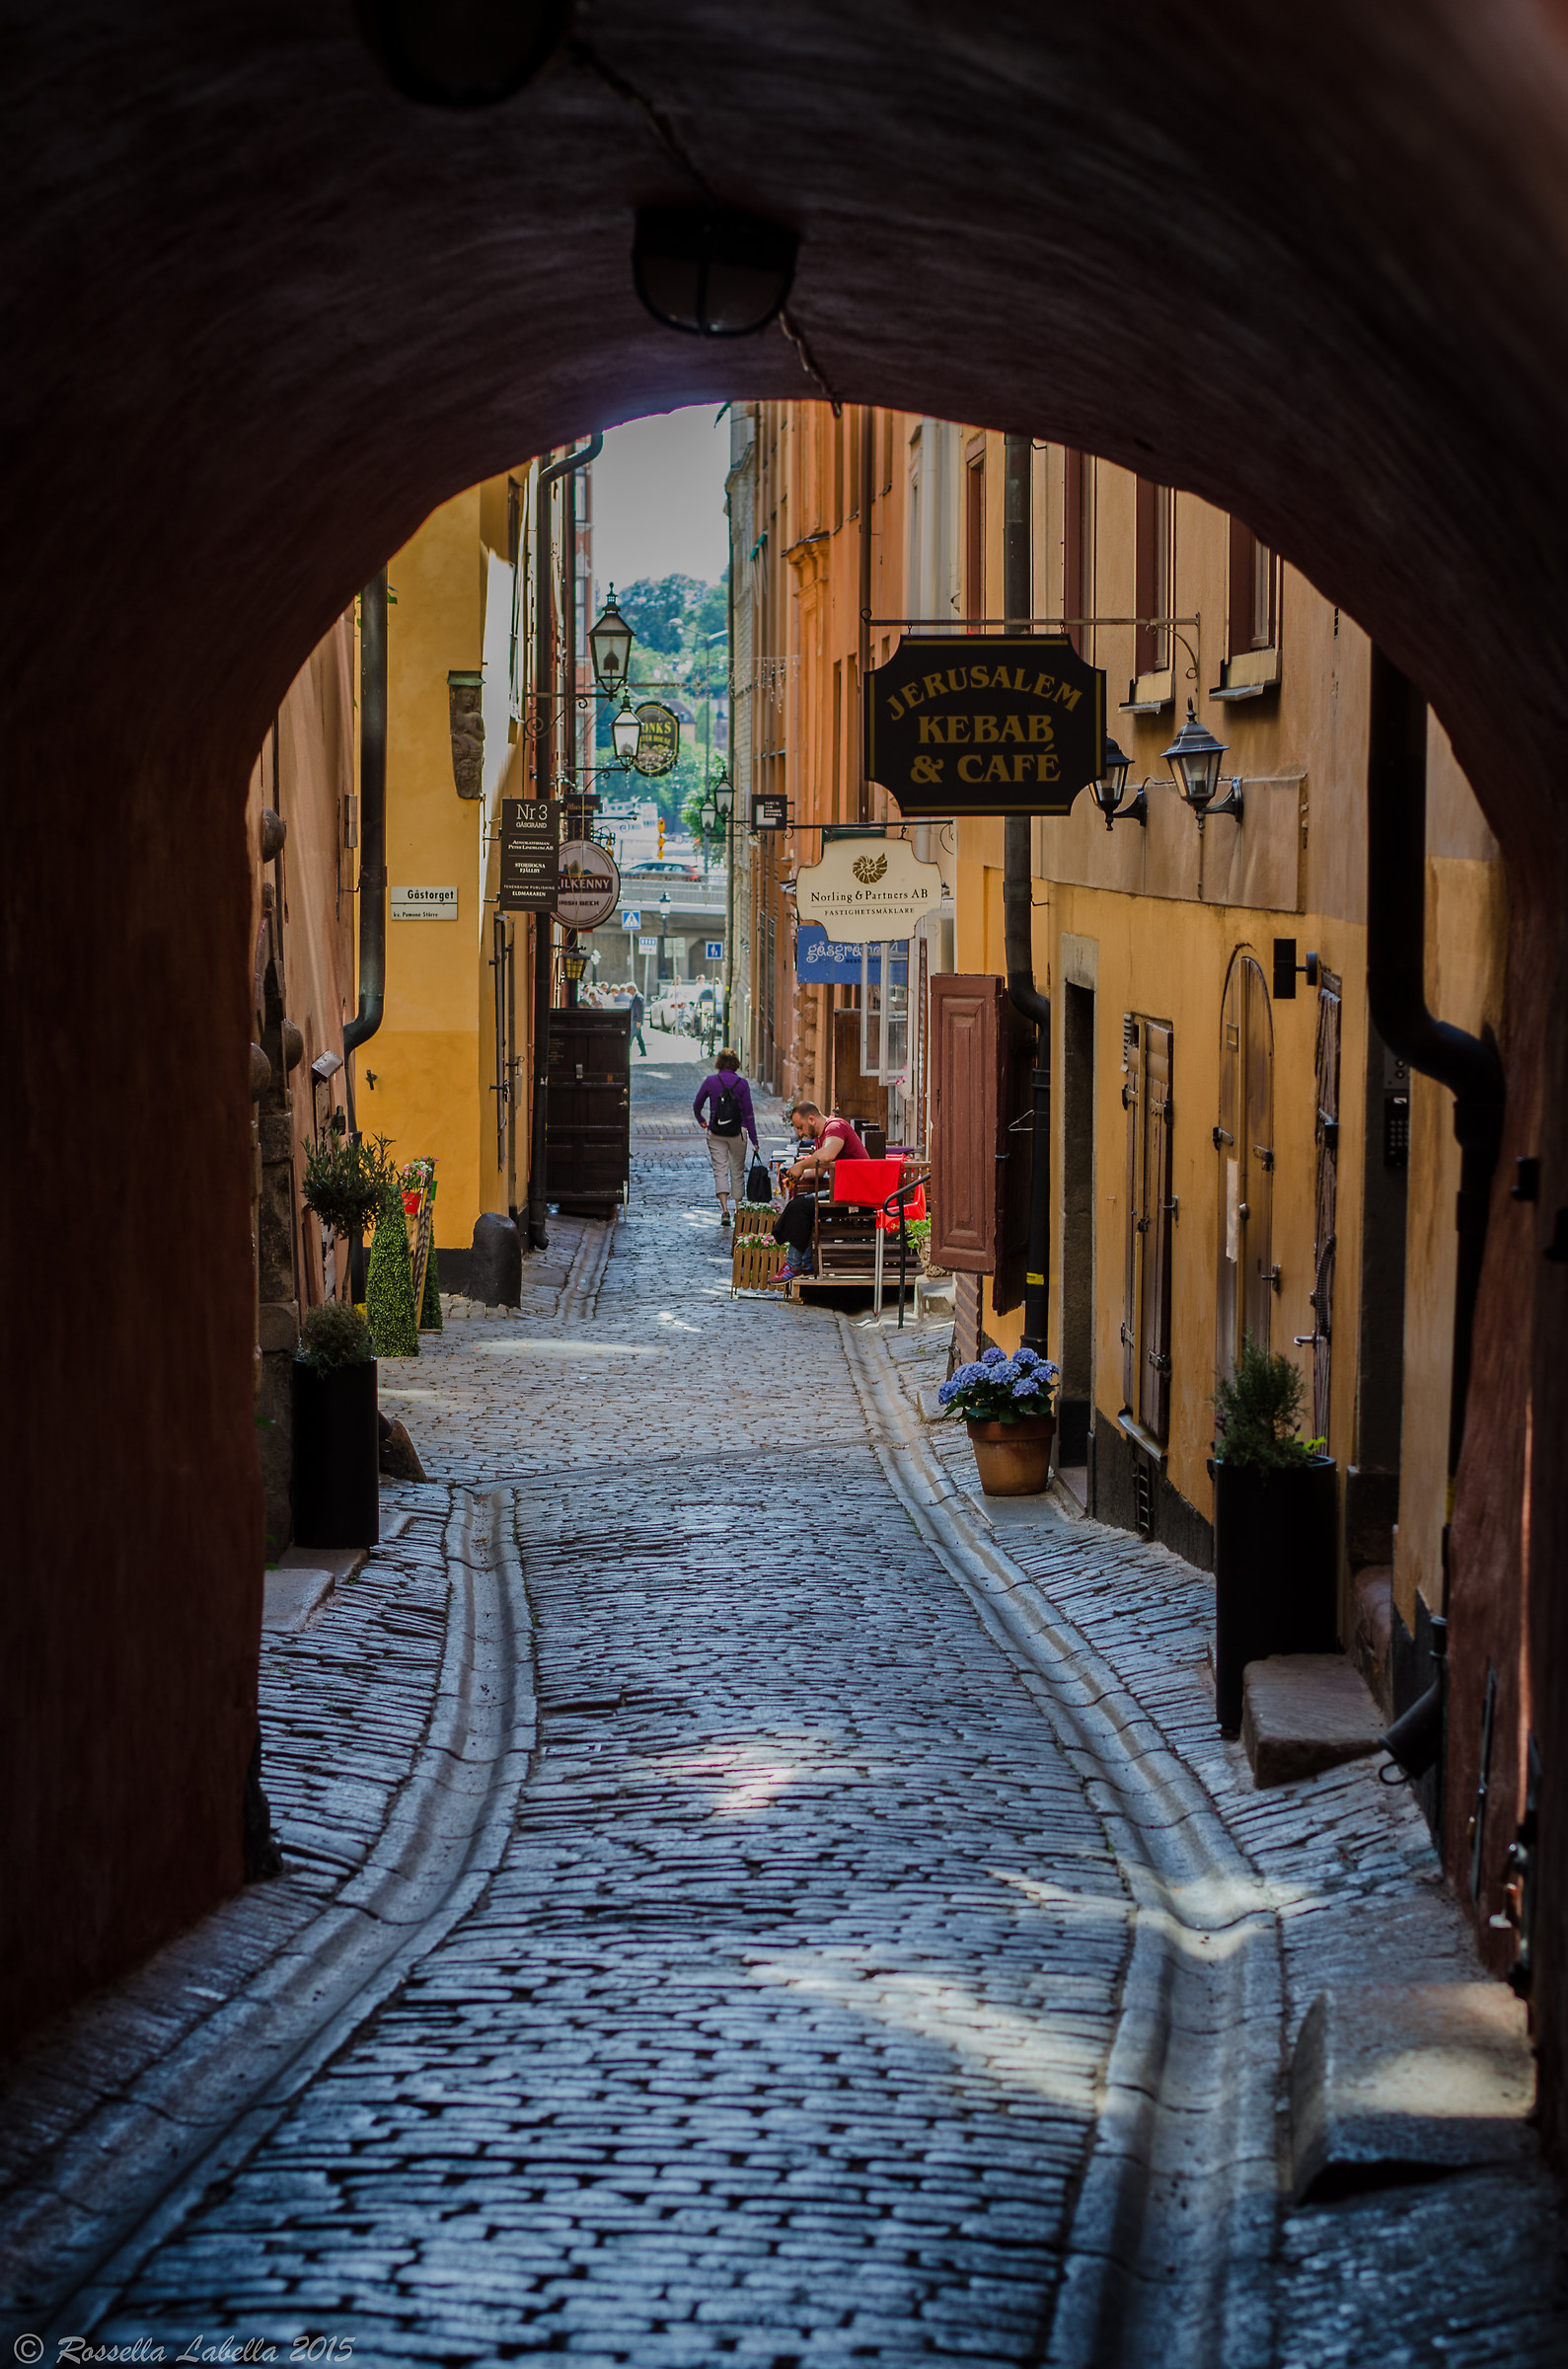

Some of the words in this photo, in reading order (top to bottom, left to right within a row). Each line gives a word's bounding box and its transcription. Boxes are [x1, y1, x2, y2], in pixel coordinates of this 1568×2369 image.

[886, 665, 1083, 721] JERUSALEM
[918, 715, 1055, 743] KEBAB
[910, 754, 944, 784] &
[956, 743, 1062, 783] CAFÉ
[516, 803, 536, 820] Nr
[538, 804, 548, 820] 3
[558, 878, 610, 889] ILKENNY
[407, 889, 454, 902] Gåstorget
[810, 891, 853, 904] Norling
[855, 890, 863, 900] &
[864, 890, 908, 900] Partners
[911, 888, 929, 898] AB
[824, 907, 916, 916] FASTIGHETSMÄKLARE
